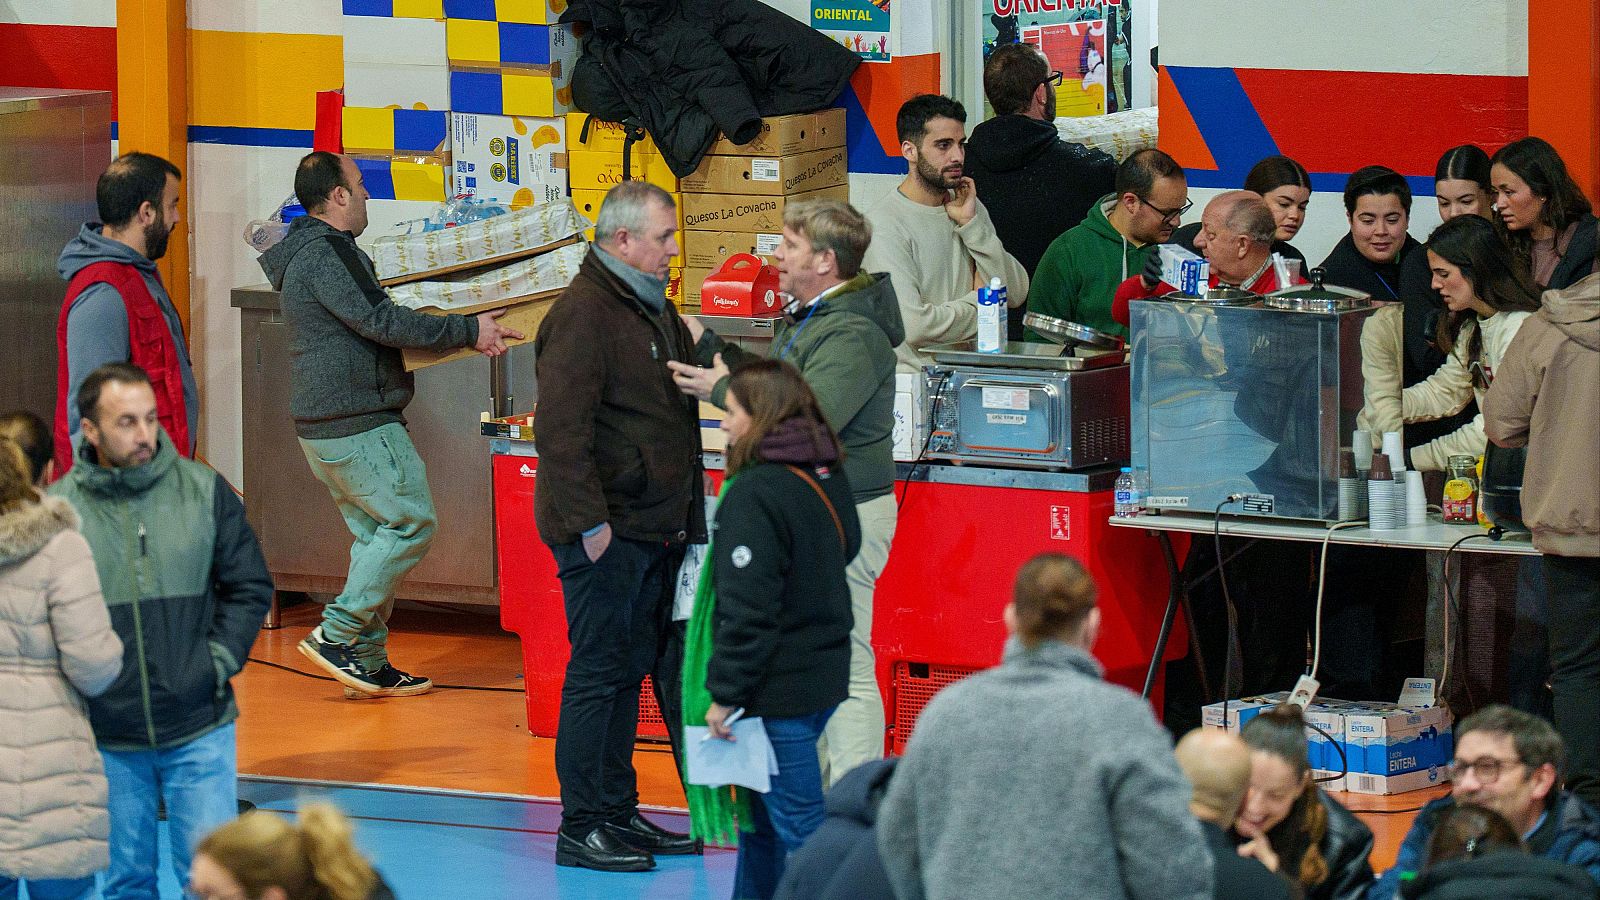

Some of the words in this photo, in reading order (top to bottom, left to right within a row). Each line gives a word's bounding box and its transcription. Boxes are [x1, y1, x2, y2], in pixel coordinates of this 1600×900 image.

[814, 8, 872, 21] ORIENTAL
[785, 172, 807, 190] Quesos
[807, 166, 817, 180] La
[817, 152, 843, 173] Covacha
[685, 211, 719, 226] Quesos
[721, 208, 734, 220] La
[736, 201, 777, 217] Covacha
[1310, 722, 1331, 730] NTERA
[1351, 725, 1375, 733] ENTERA
[1389, 751, 1402, 760] Leche
[1389, 756, 1417, 772] ENTERA
